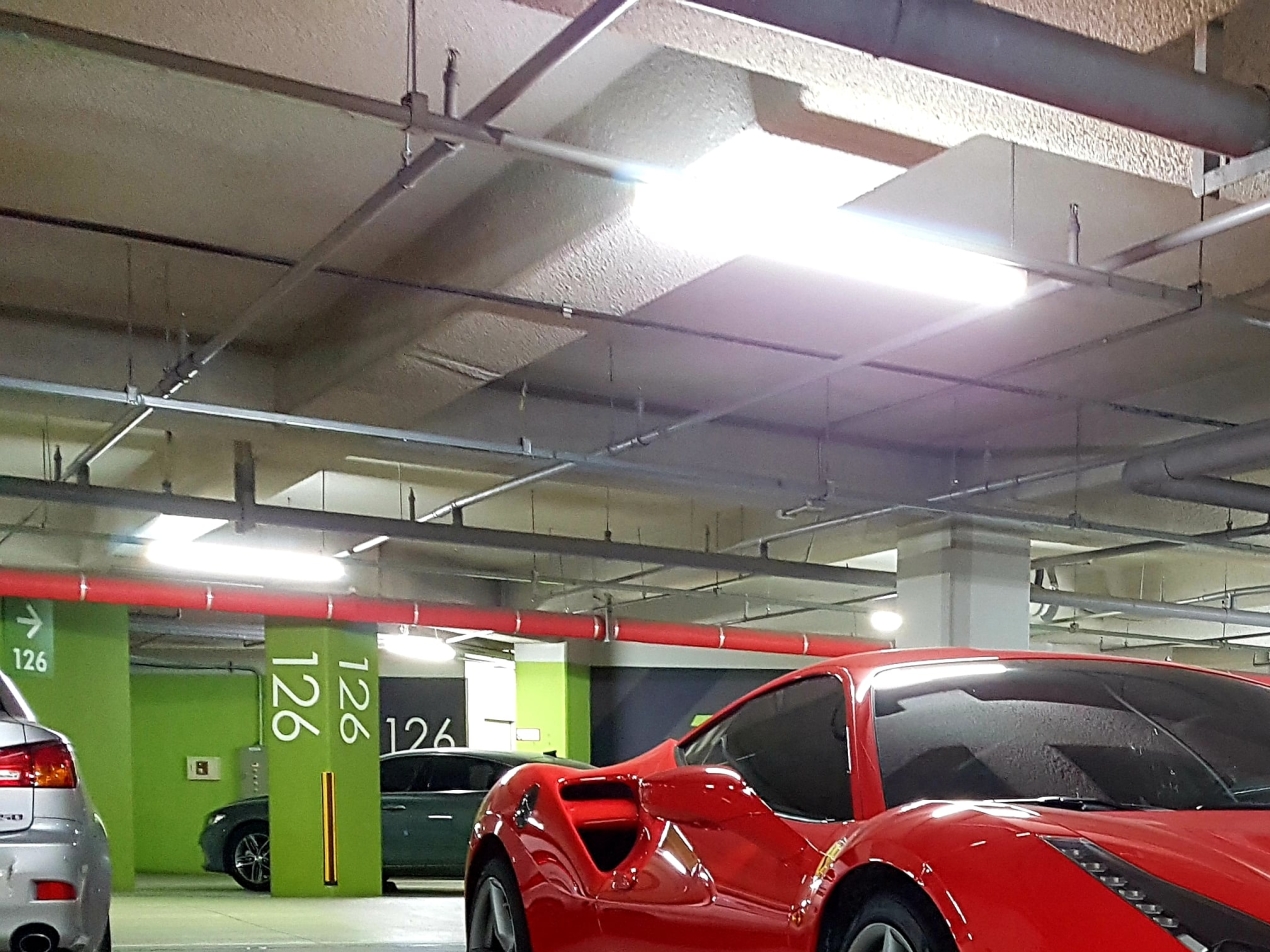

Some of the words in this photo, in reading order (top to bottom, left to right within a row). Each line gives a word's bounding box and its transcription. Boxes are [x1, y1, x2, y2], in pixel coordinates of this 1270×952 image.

[12, 647, 48, 673] 126
[271, 651, 321, 742] 126
[338, 657, 371, 744] 126
[386, 716, 455, 753] 126
